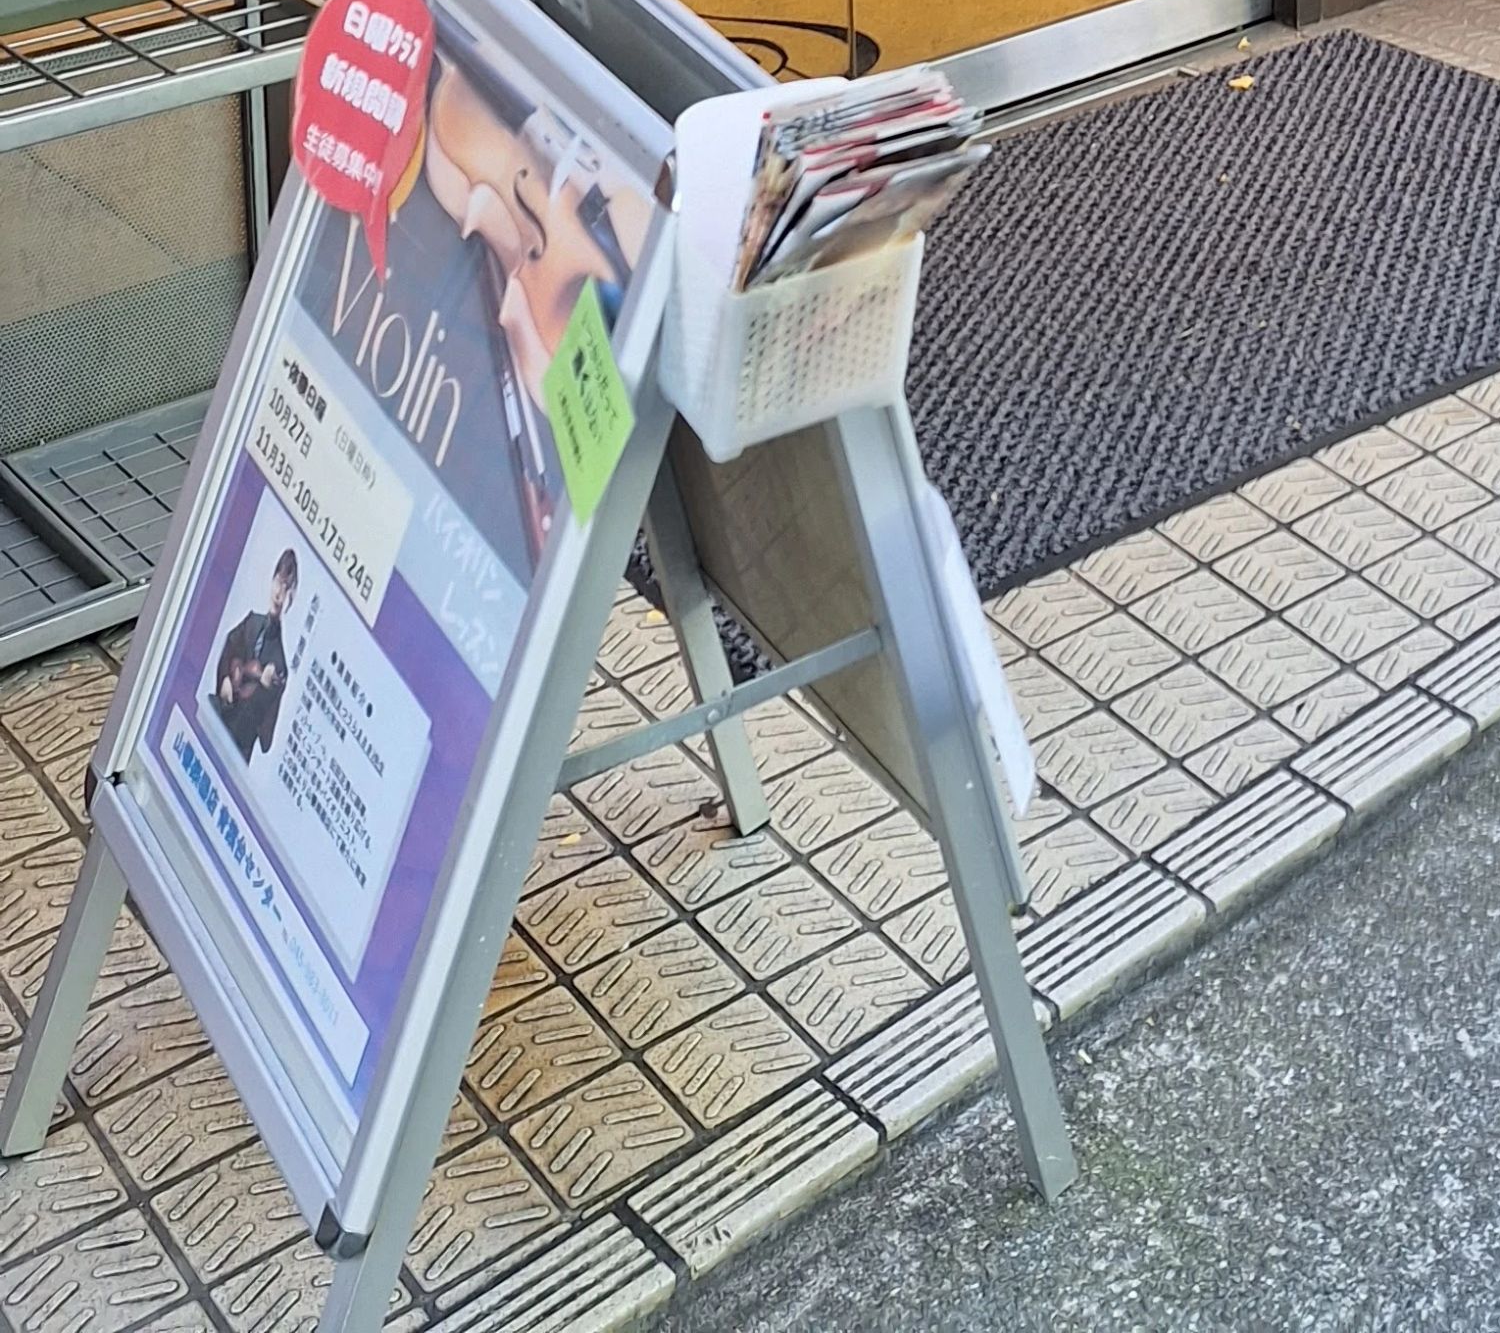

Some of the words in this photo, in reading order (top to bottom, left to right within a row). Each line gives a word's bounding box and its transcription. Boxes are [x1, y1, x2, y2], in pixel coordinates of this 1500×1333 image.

[342, 0, 422, 68] 日曜クラス
[332, 211, 463, 468] Violin
[268, 386, 312, 459] 10月27日
